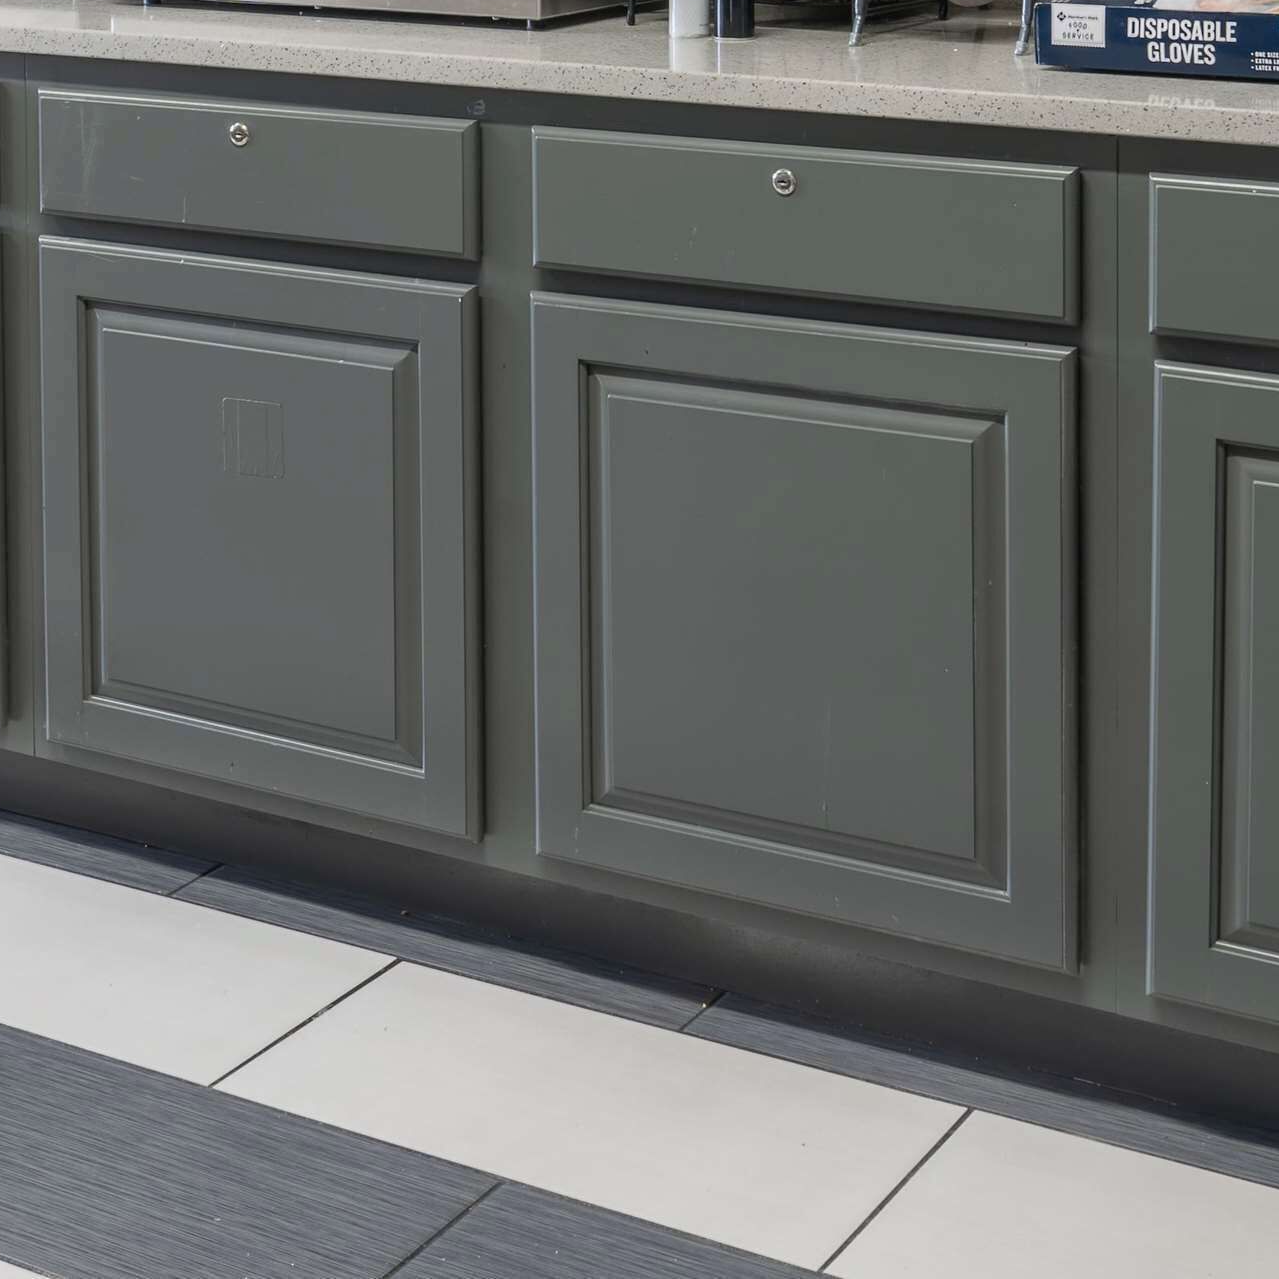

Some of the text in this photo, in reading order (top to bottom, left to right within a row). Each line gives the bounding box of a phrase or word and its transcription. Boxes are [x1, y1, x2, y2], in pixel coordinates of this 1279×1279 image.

[1068, 22, 1088, 30] FOOD
[1127, 17, 1237, 42] DISPOSABLE
[1062, 32, 1094, 40] SERVICE
[1147, 41, 1216, 65] GLOVES
